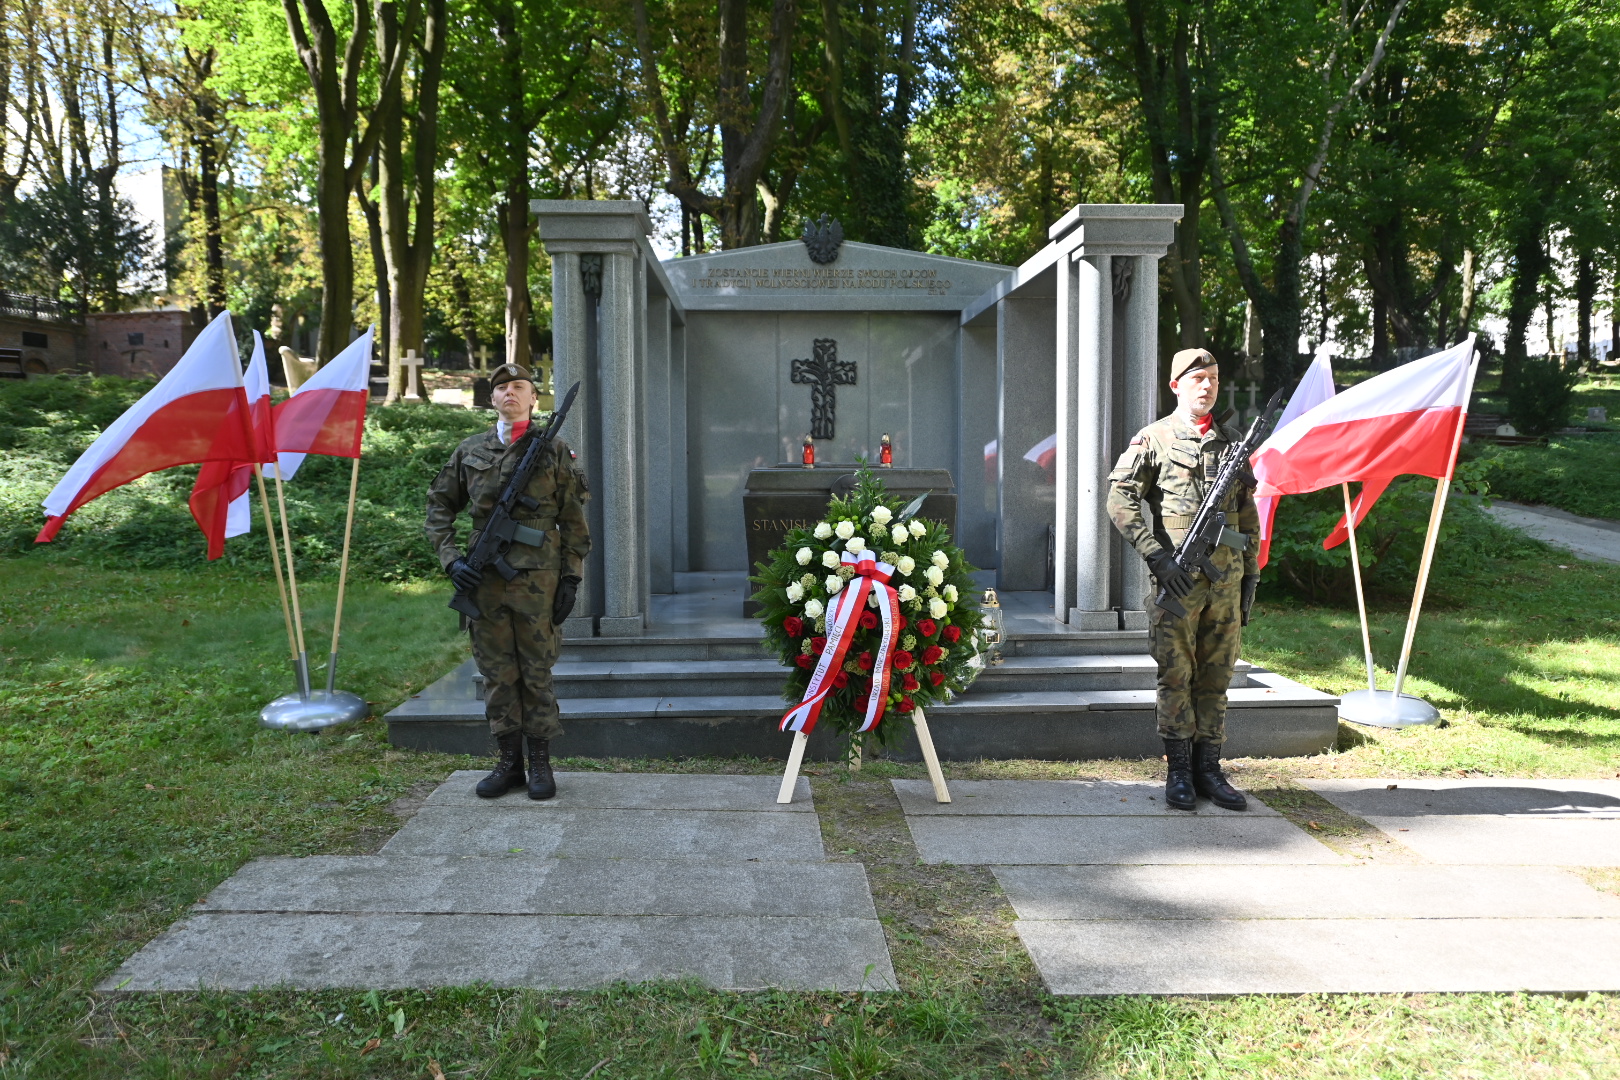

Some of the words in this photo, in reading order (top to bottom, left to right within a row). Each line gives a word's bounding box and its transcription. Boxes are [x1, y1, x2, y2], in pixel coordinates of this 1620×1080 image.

[772, 268, 810, 278] WIERNI
[813, 268, 853, 278] WIERZE
[857, 269, 897, 278] SWOICH
[842, 279, 886, 289] NARODU
[889, 280, 951, 289] POLSKIEGO
[752, 519, 822, 531] STANISŁ
